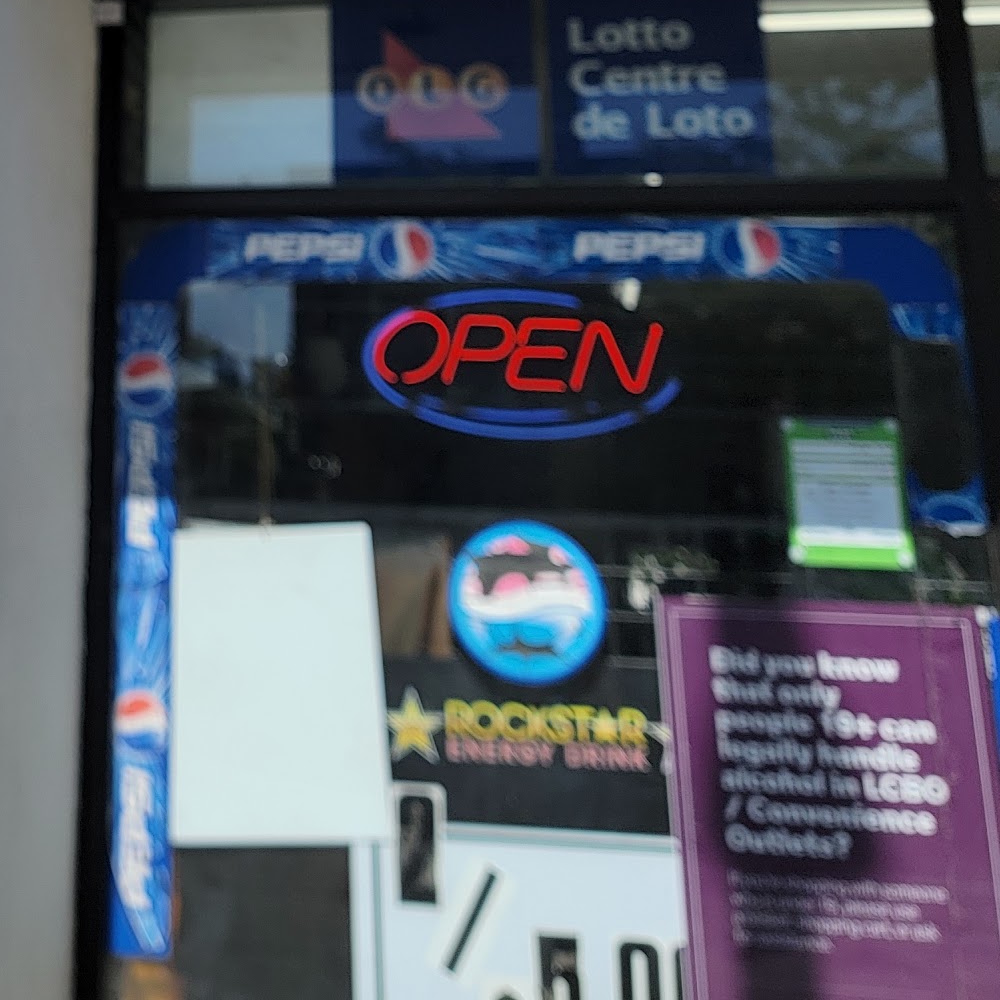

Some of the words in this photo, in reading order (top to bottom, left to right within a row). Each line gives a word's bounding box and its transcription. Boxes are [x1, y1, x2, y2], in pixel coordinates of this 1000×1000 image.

[567, 17, 694, 54] Lotto
[568, 59, 729, 98] Centre
[572, 103, 631, 141] de
[646, 102, 757, 141] Loto
[243, 230, 365, 264] PEPSI
[573, 230, 705, 264] PEPSI
[373, 310, 664, 394] OPEN
[816, 649, 900, 683] know
[877, 717, 938, 744] can
[861, 770, 950, 806] LCBO
[746, 794, 938, 836] Convenience
